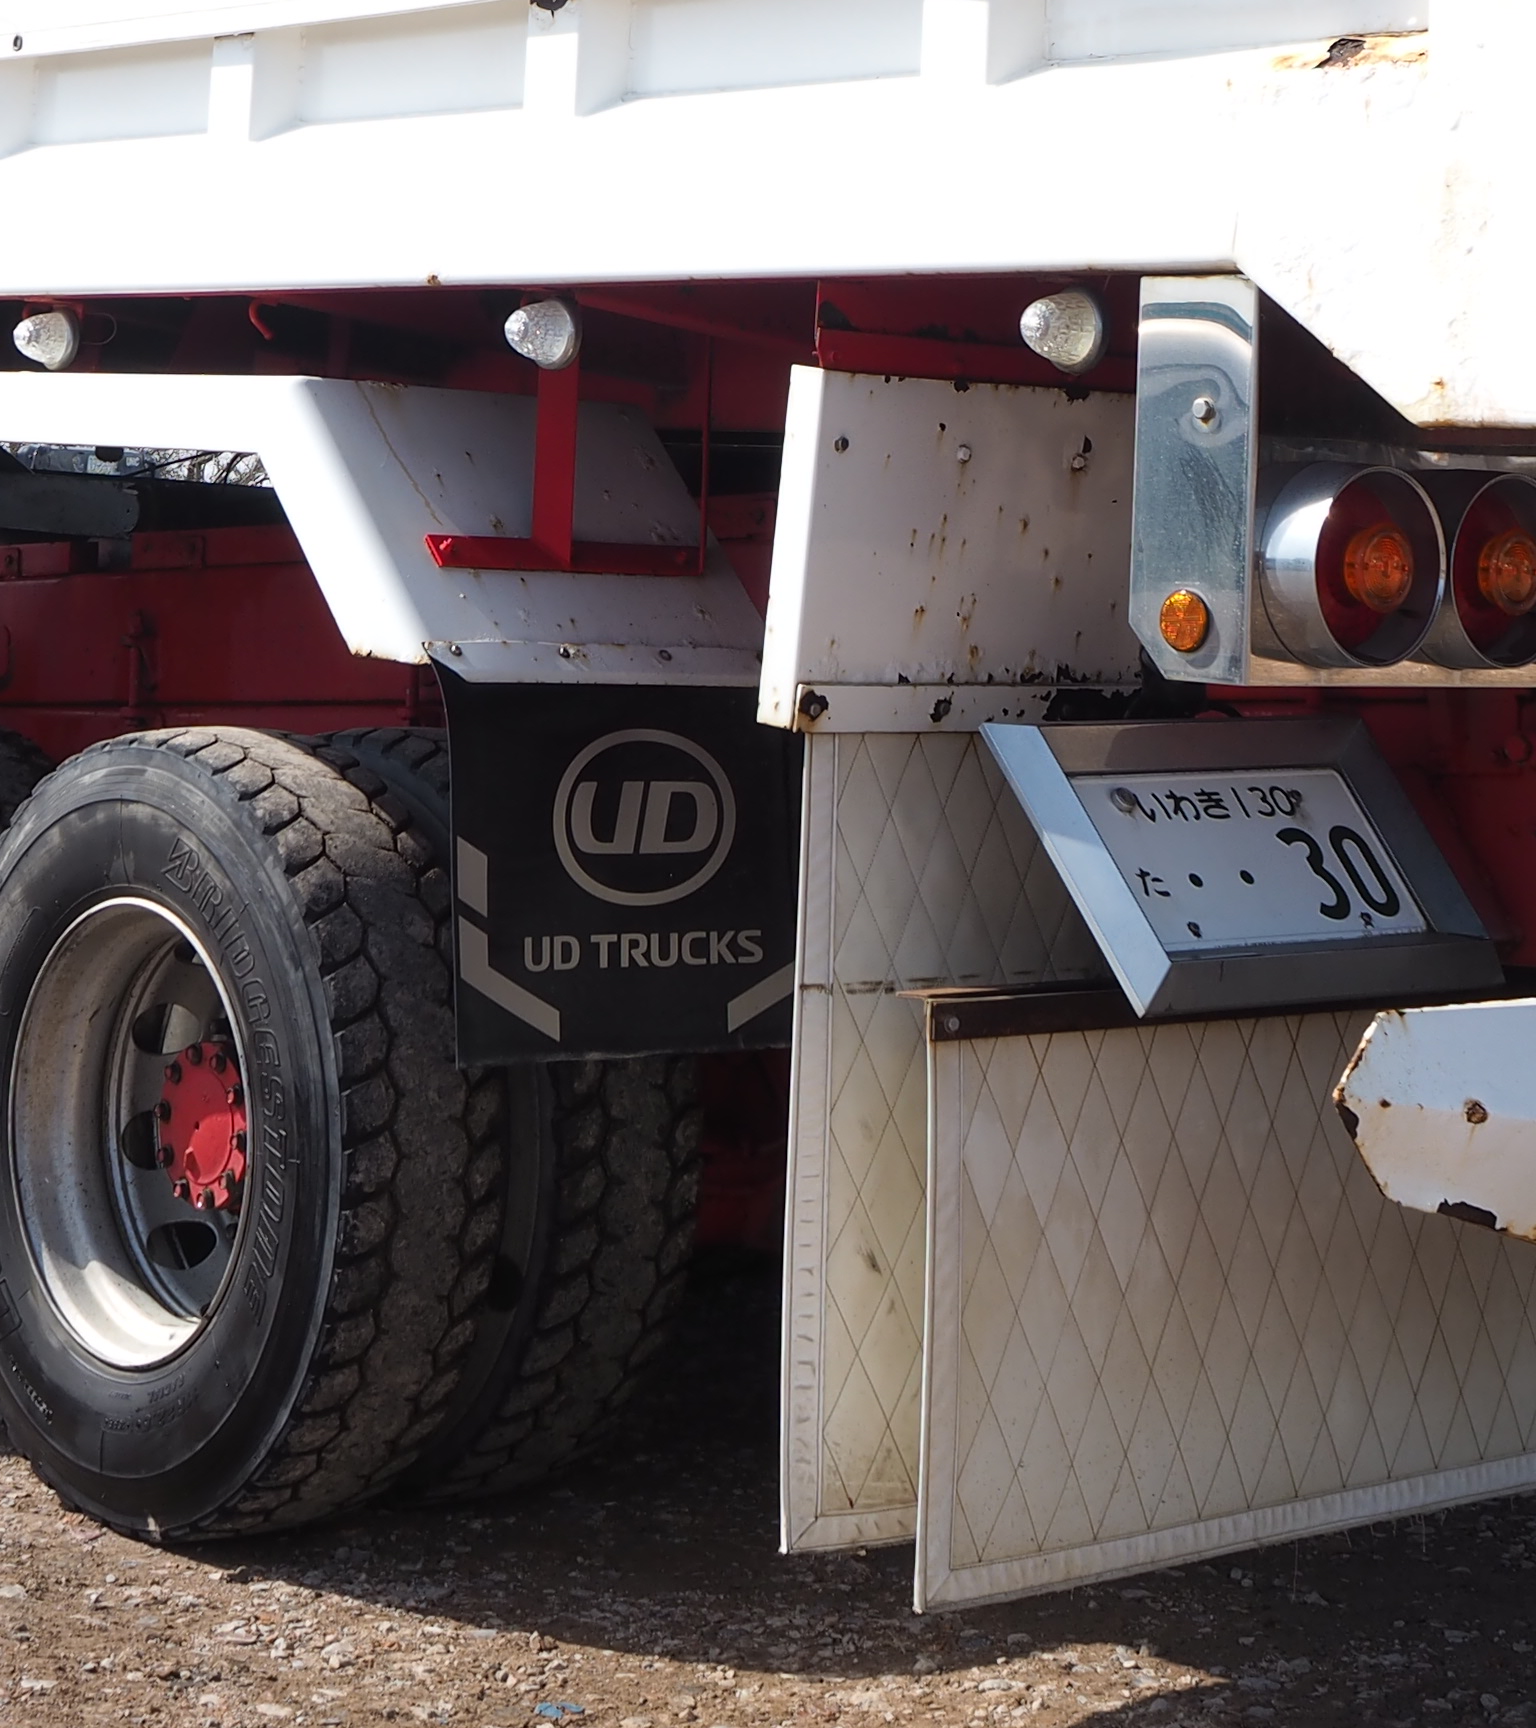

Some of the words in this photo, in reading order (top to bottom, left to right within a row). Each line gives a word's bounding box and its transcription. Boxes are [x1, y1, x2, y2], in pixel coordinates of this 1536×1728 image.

[571, 780, 718, 854] UD
[523, 936, 581, 972] UD
[589, 929, 764, 969] TRUCKS
[162, 837, 288, 1329] BRIDGESTONE
